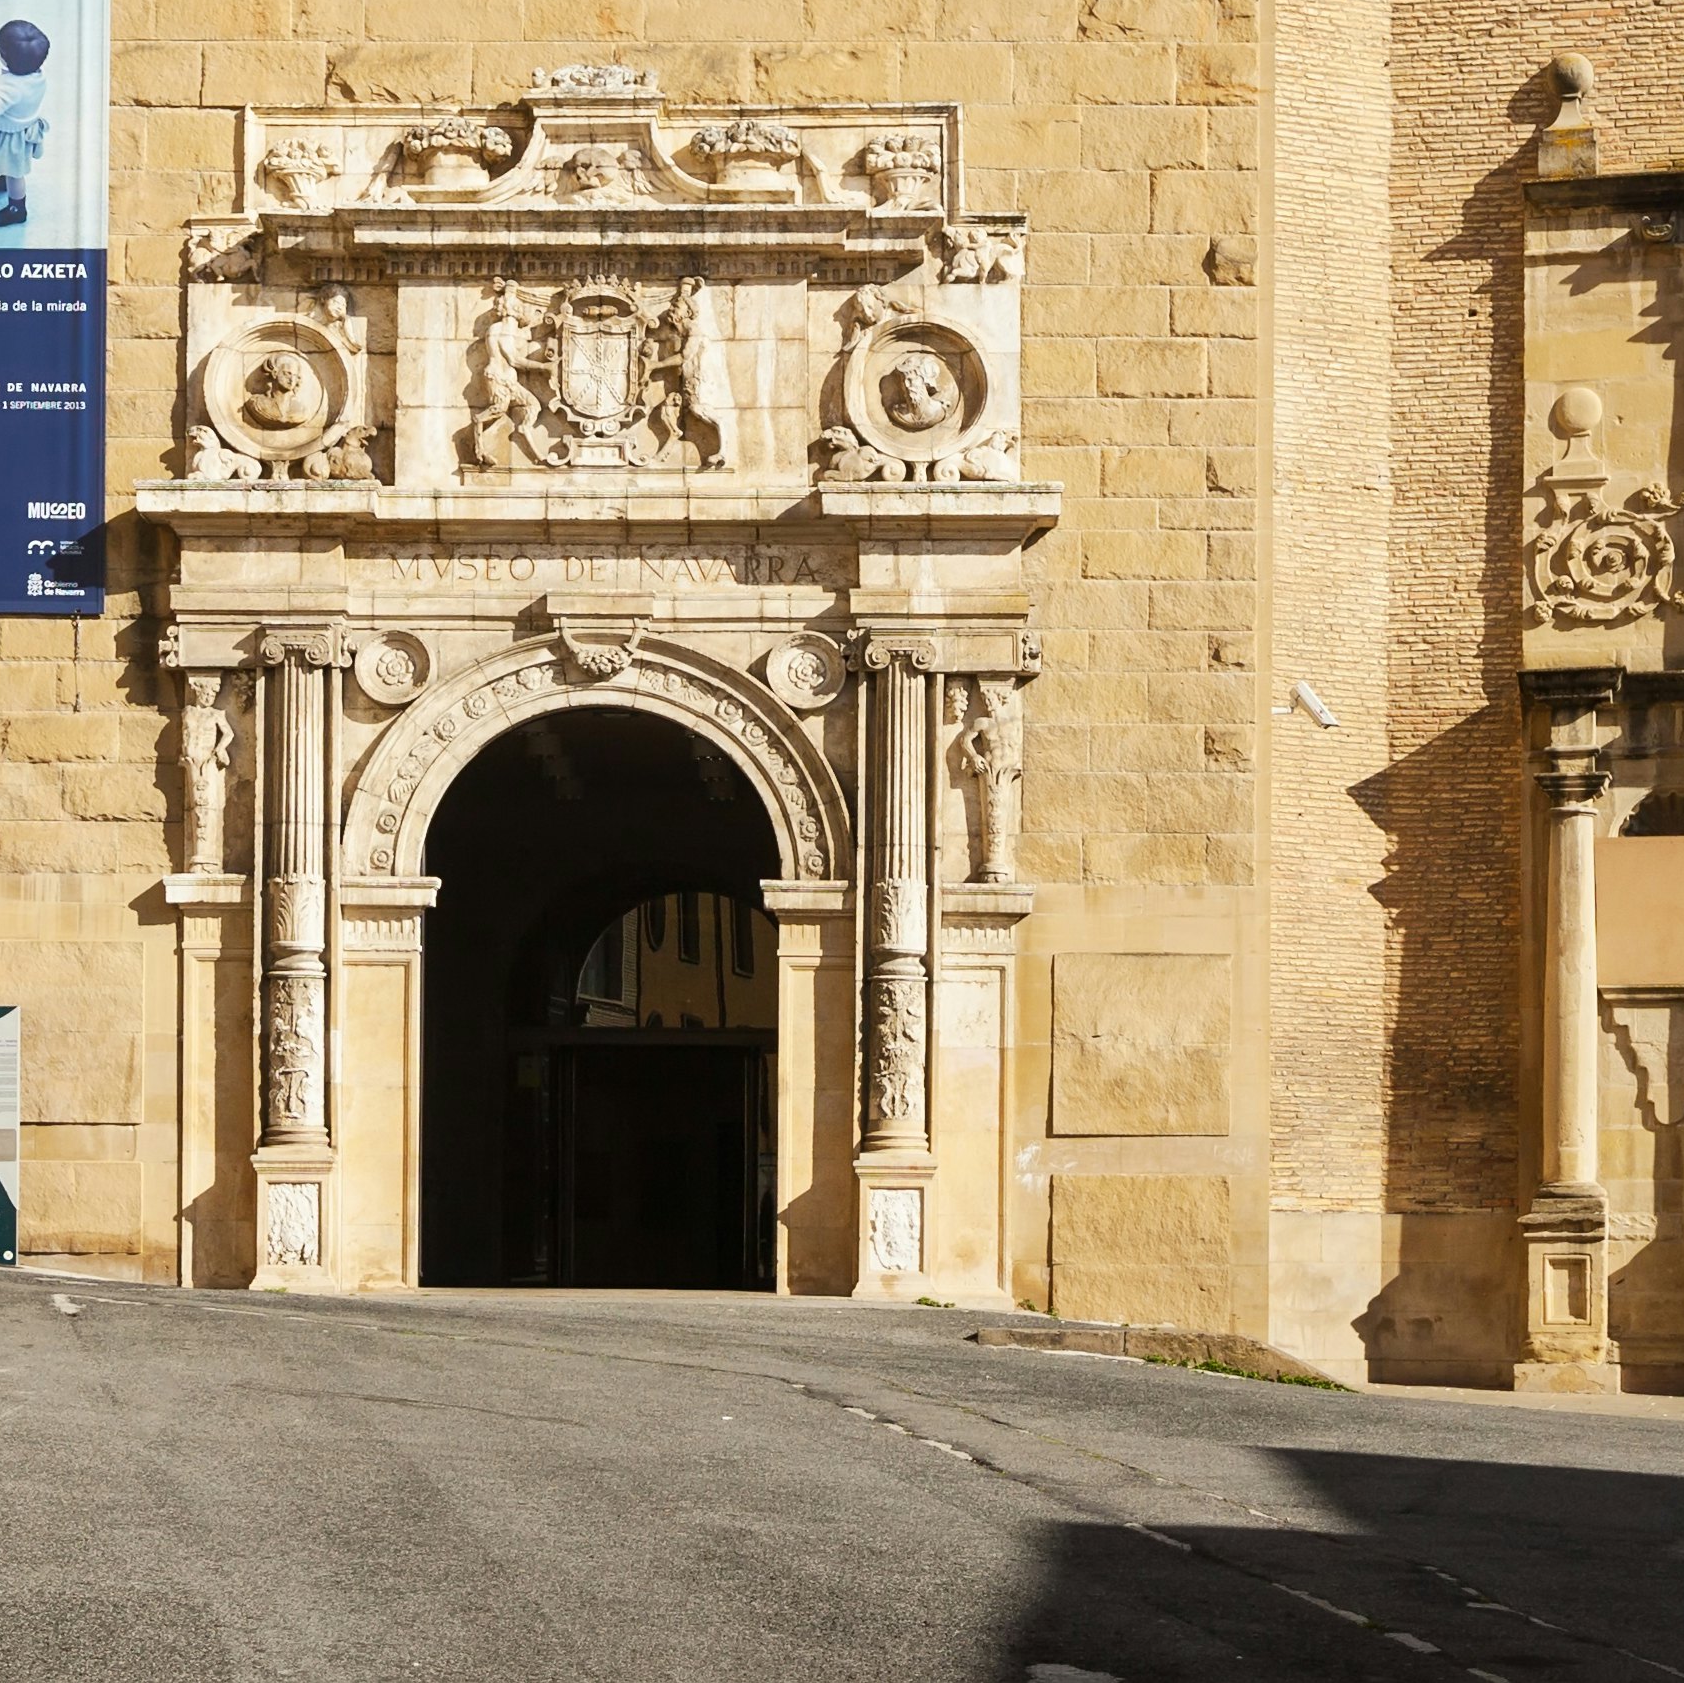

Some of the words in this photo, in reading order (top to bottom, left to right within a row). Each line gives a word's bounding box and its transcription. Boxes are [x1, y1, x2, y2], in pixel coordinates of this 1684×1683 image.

[20, 263, 88, 278] AZKETA
[12, 300, 28, 312] de
[31, 300, 43, 312] la
[46, 300, 87, 312] mirada
[7, 382, 23, 392] DE
[30, 383, 87, 393] NAVARRA
[2, 401, 8, 410] 1
[9, 401, 63, 410] SEPTIEMBRE
[63, 401, 86, 410] 2013
[28, 502, 86, 519] MUSEO
[564, 555, 605, 583] DE
[639, 554, 818, 584] NAVARRA
